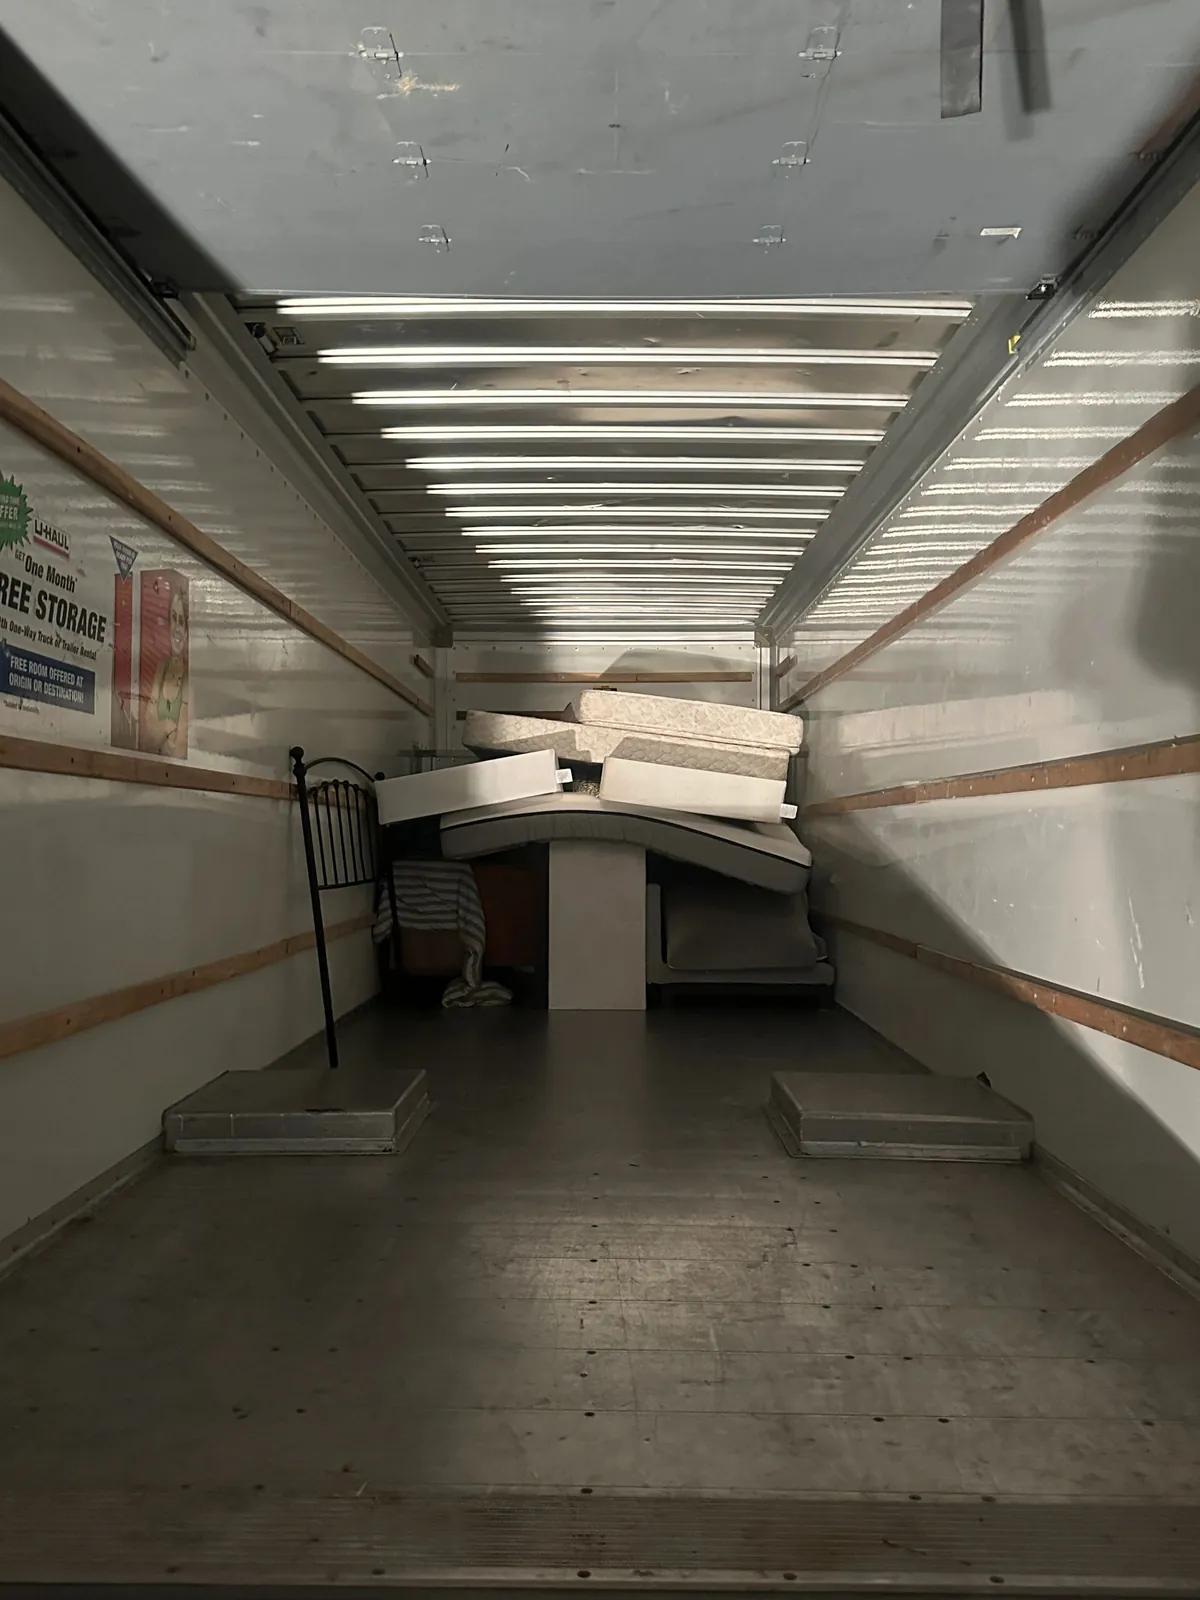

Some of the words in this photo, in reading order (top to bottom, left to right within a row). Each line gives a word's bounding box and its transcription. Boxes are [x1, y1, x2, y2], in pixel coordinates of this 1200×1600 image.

[34, 519, 69, 550] U-HAUL
[15, 549, 25, 561] GET
[25, 555, 44, 578] One
[35, 589, 107, 643] STORAGE
[0, 616, 8, 630] th
[9, 620, 37, 641] One-Way
[38, 631, 53, 646] Truck
[54, 638, 61, 648] or
[62, 639, 79, 655] Trailer
[80, 646, 97, 661] Rental
[10, 655, 28, 672] FREE
[28, 660, 48, 678] ROOM
[49, 666, 75, 686] OFFERED
[76, 676, 84, 688] AT
[9, 672, 32, 691] ORIGIN
[33, 678, 43, 693] OR
[43, 682, 84, 704] DESTINATION!
